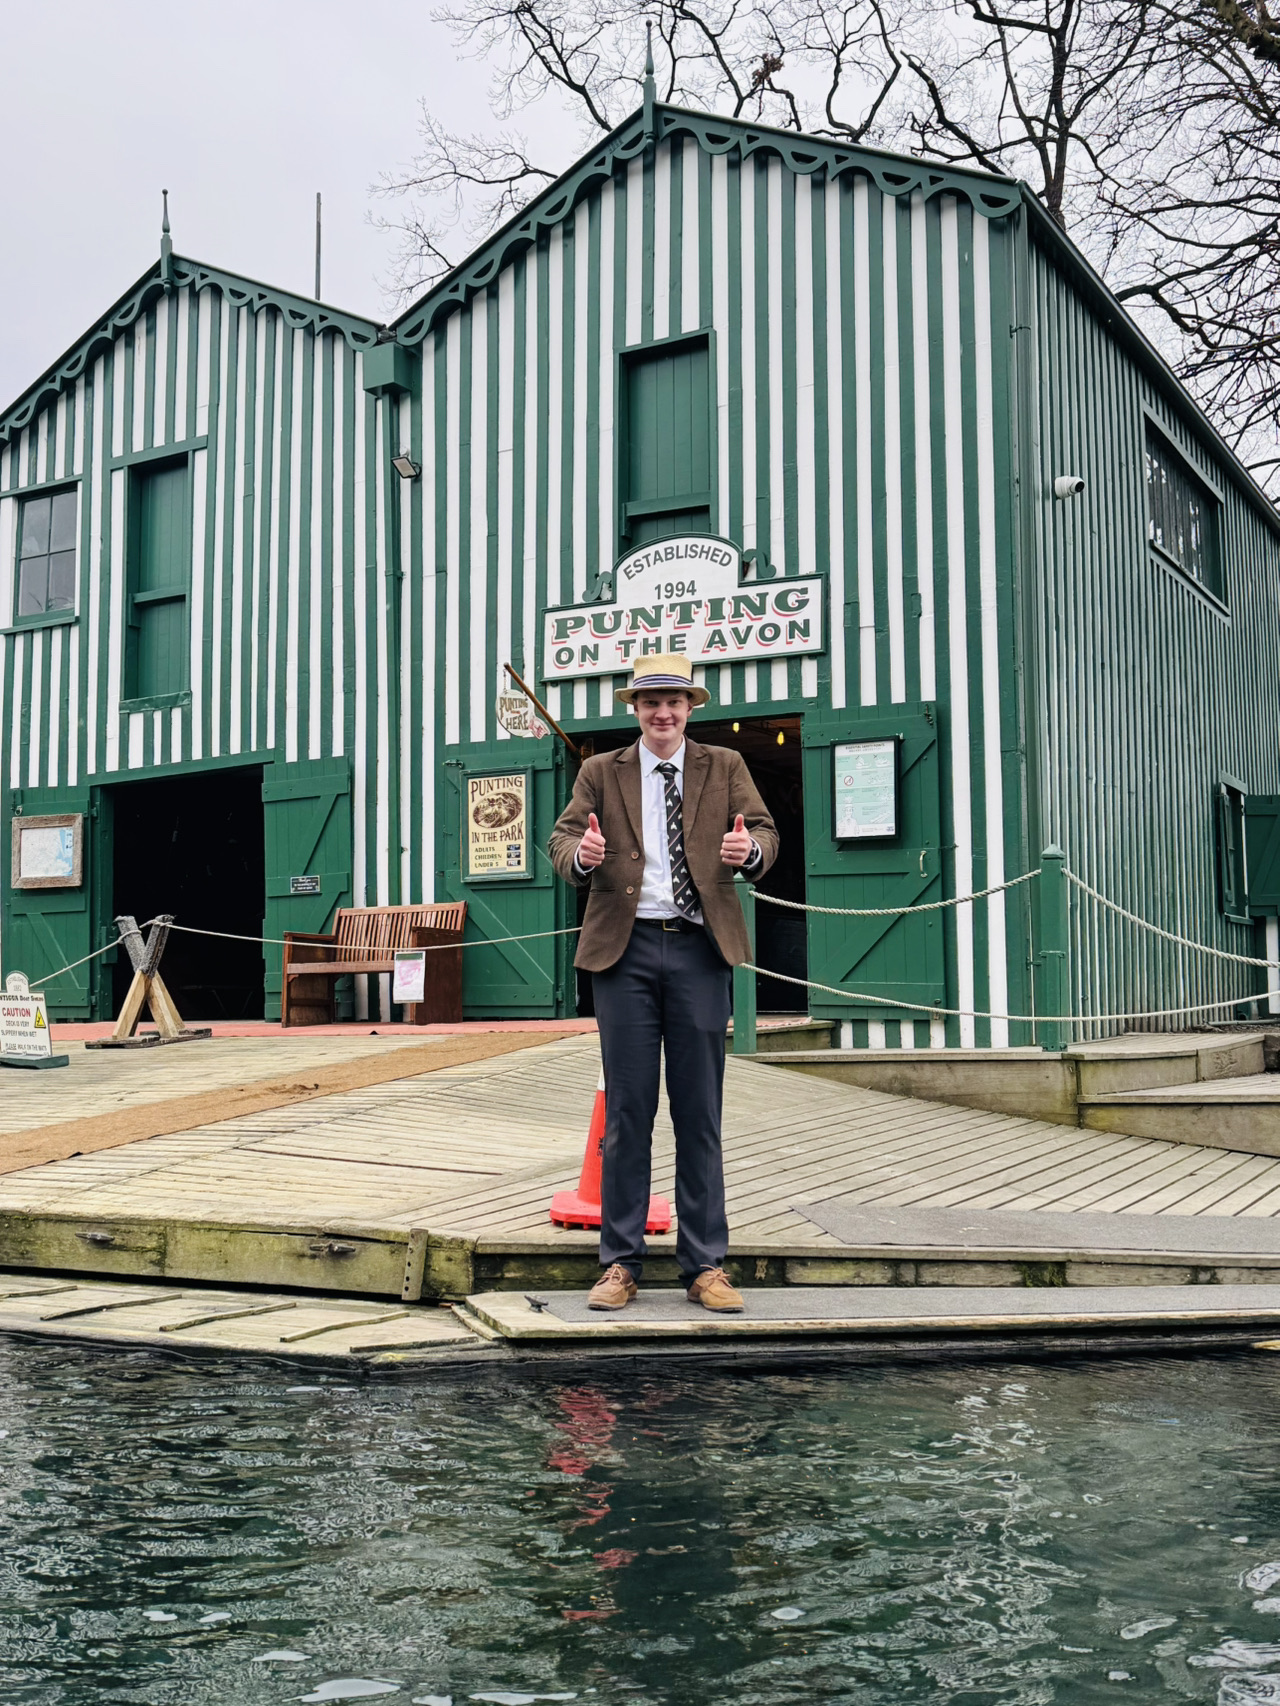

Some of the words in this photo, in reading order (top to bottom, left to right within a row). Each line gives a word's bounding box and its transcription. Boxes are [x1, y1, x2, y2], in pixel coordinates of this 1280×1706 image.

[623, 543, 733, 580] ESTABLISHED
[654, 580, 697, 600] 1994
[552, 587, 810, 644] PUNTING
[554, 643, 600, 669] ON
[616, 633, 687, 663] THE
[702, 618, 811, 653] AVON
[499, 697, 529, 720] PUNTING
[506, 710, 529, 730] HERE
[471, 776, 523, 803] PUNTING
[472, 832, 480, 844] IN
[481, 832, 498, 843] THE
[500, 821, 524, 842] PARK
[474, 853, 502, 861] CHILDREN
[2, 1007, 31, 1018] CAUTION
